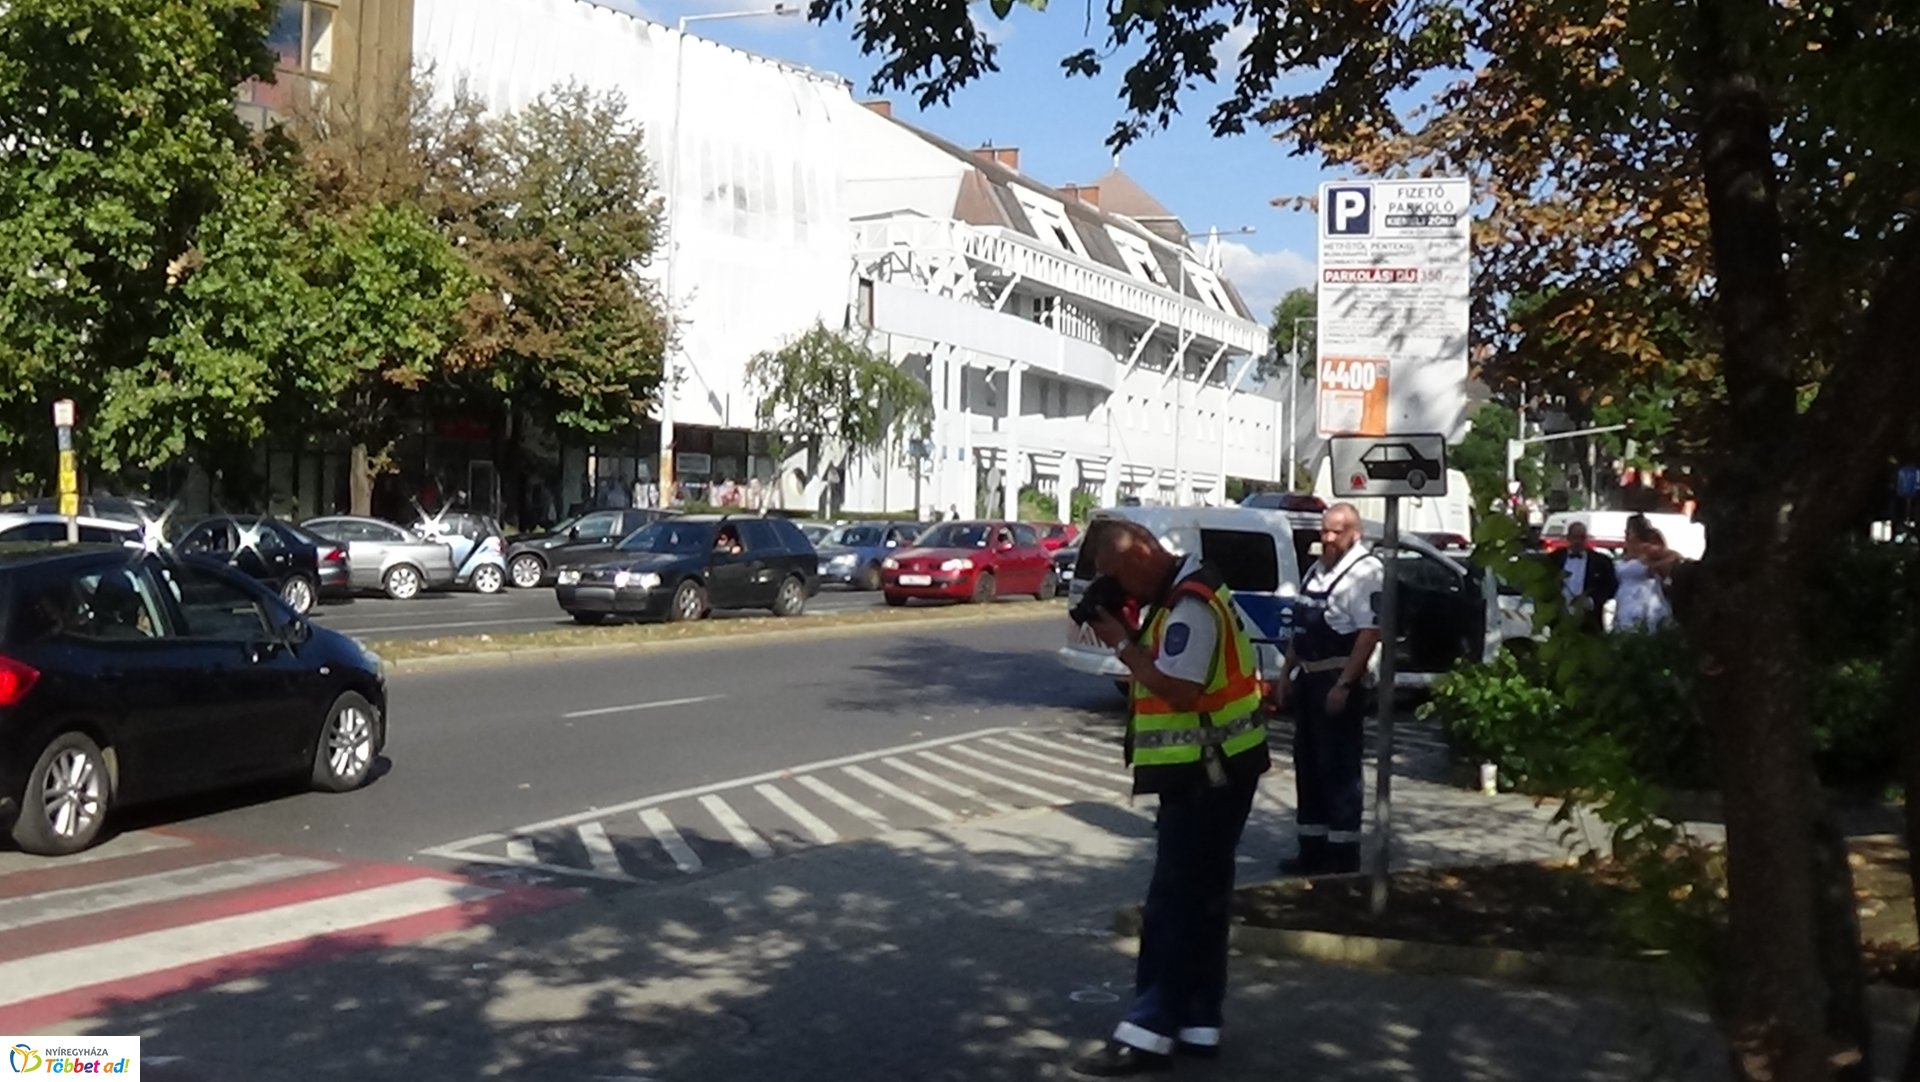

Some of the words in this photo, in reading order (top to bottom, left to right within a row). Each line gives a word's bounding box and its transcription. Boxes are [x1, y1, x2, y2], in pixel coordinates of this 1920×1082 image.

[1397, 185, 1445, 199] FIZETŐ
[1335, 190, 1366, 232] P
[1388, 201, 1455, 213] PARKOLÓ
[1322, 360, 1376, 391] 4400
